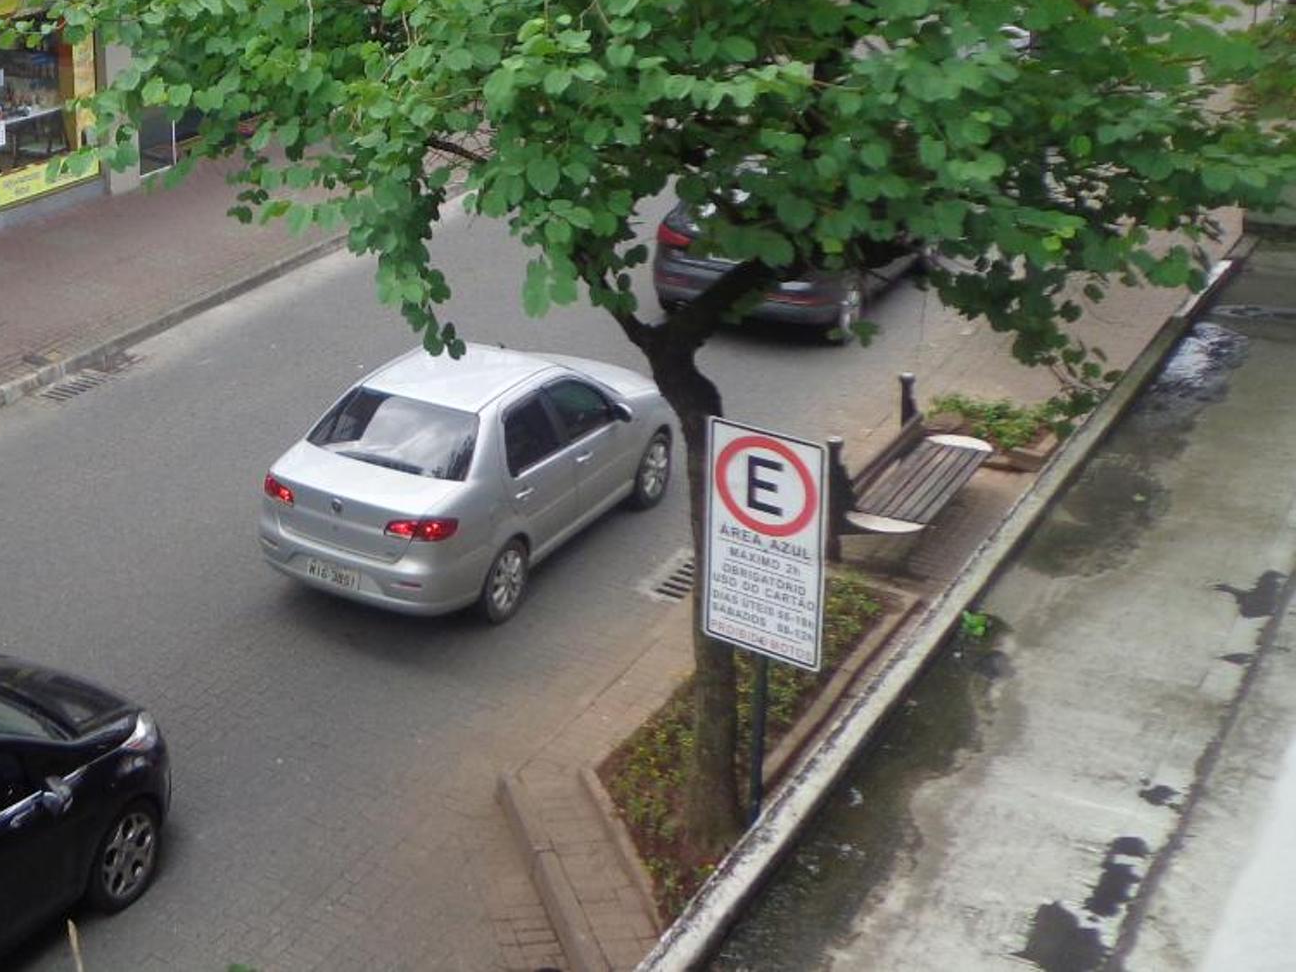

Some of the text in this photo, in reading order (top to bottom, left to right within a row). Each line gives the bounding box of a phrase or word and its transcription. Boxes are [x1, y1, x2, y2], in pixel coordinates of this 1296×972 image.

[746, 454, 784, 517] E
[770, 539, 811, 560] AZUL
[713, 571, 738, 588] USO
[742, 579, 760, 595] DO
